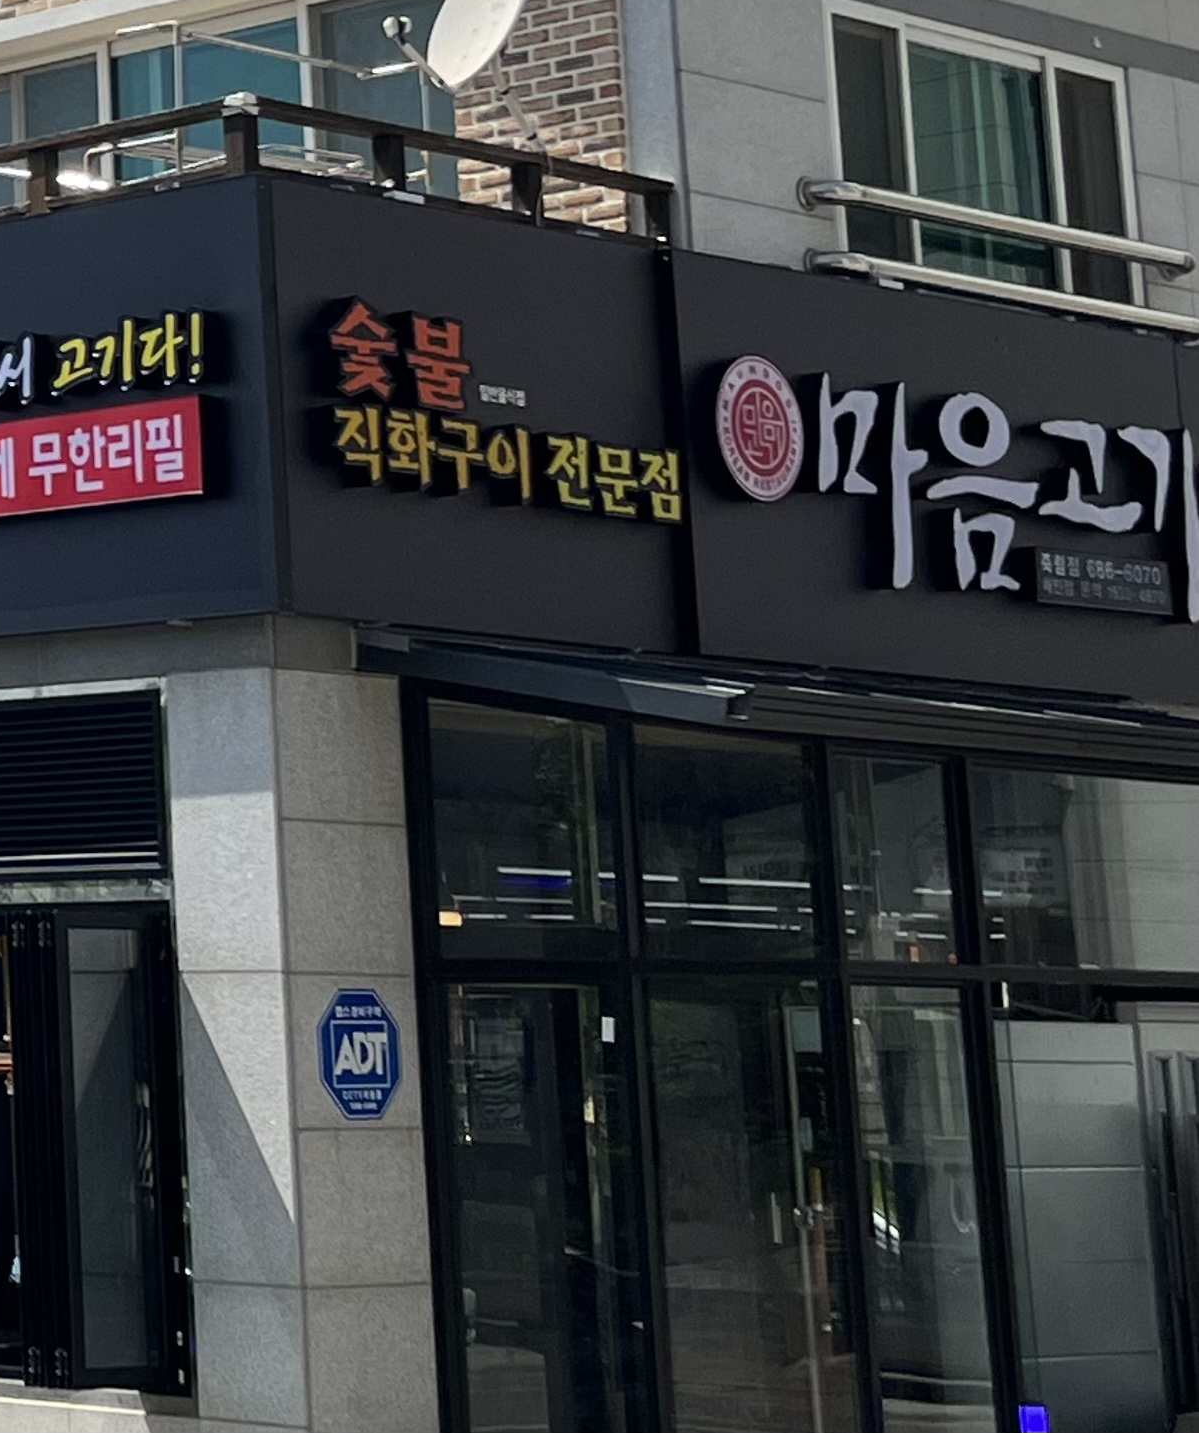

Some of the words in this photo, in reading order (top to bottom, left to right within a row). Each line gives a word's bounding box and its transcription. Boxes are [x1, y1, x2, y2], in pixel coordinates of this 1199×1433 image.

[52, 312, 201, 391] 고기다!
[331, 302, 470, 410] 숯불
[28, 414, 185, 496] 무한리필
[334, 404, 531, 503] 직화구이
[546, 432, 682, 519] 전문점
[818, 372, 1199, 623] 마음고기
[334, 1031, 387, 1076] ADT
